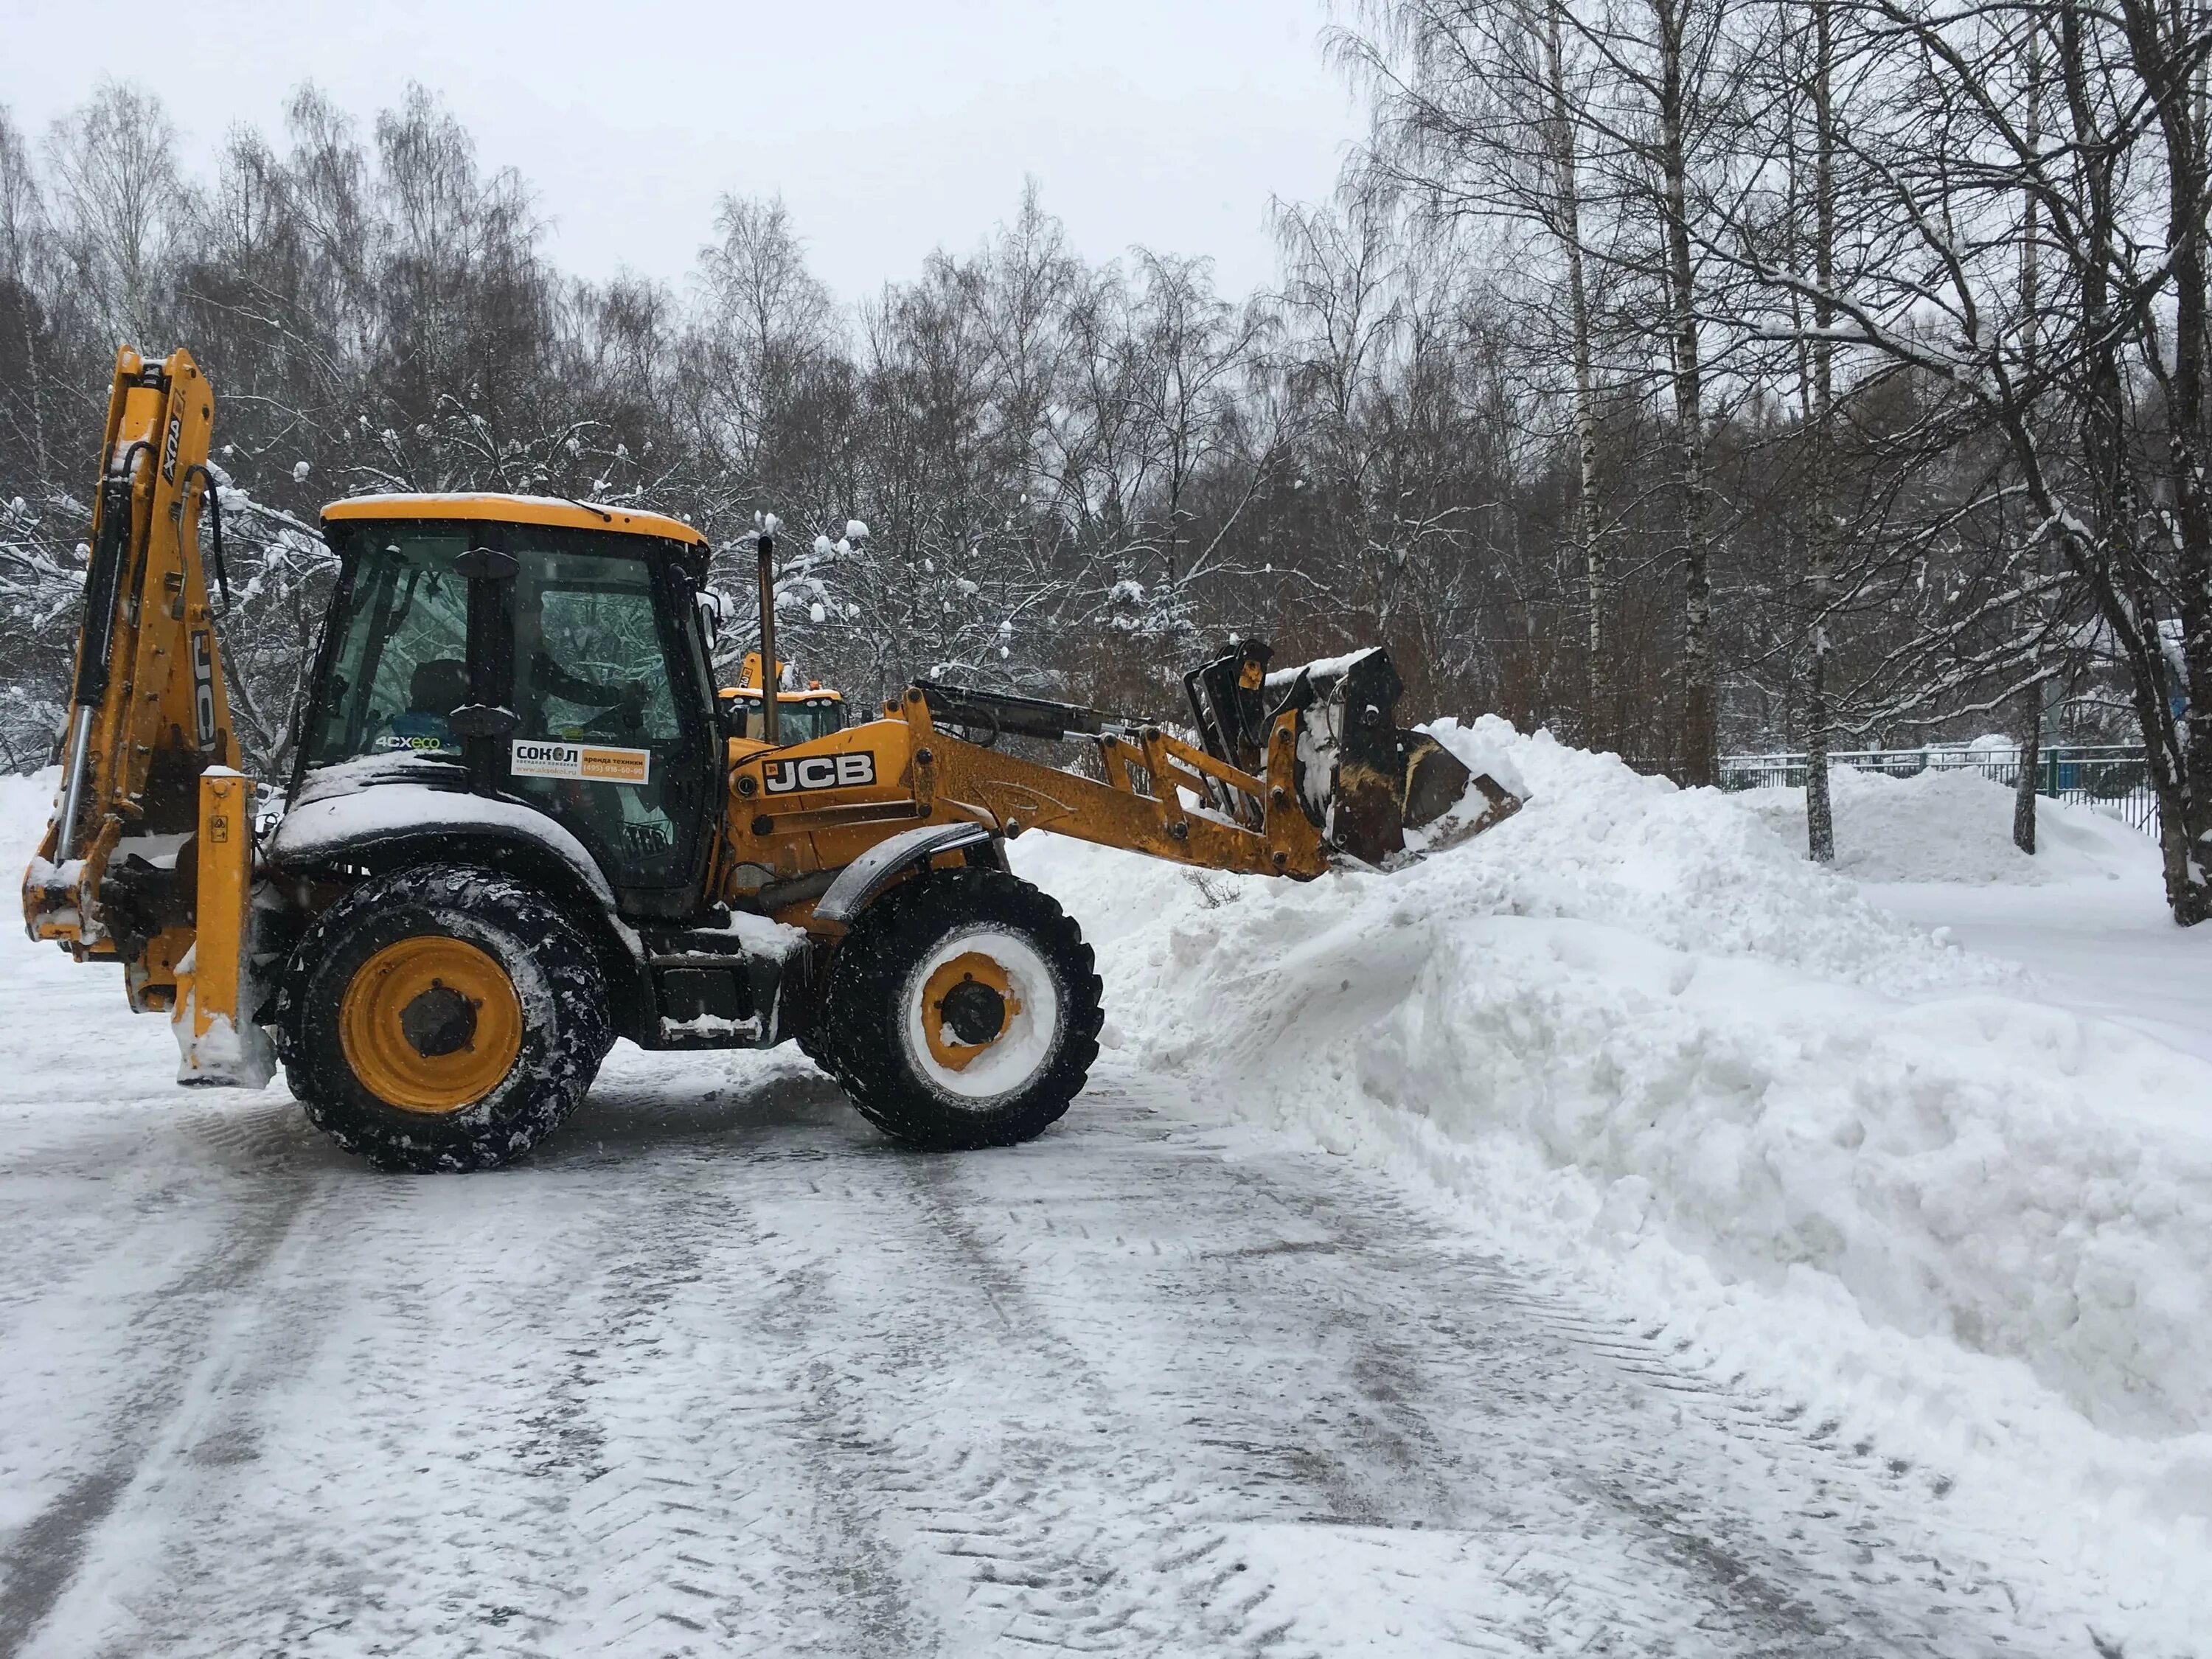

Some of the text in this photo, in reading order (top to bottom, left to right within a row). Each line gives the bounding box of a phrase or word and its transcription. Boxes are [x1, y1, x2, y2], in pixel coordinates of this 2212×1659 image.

[194, 636, 215, 751] JC
[584, 757, 611, 765] аренда
[584, 764, 603, 773] (495)
[767, 754, 873, 791] JCB
